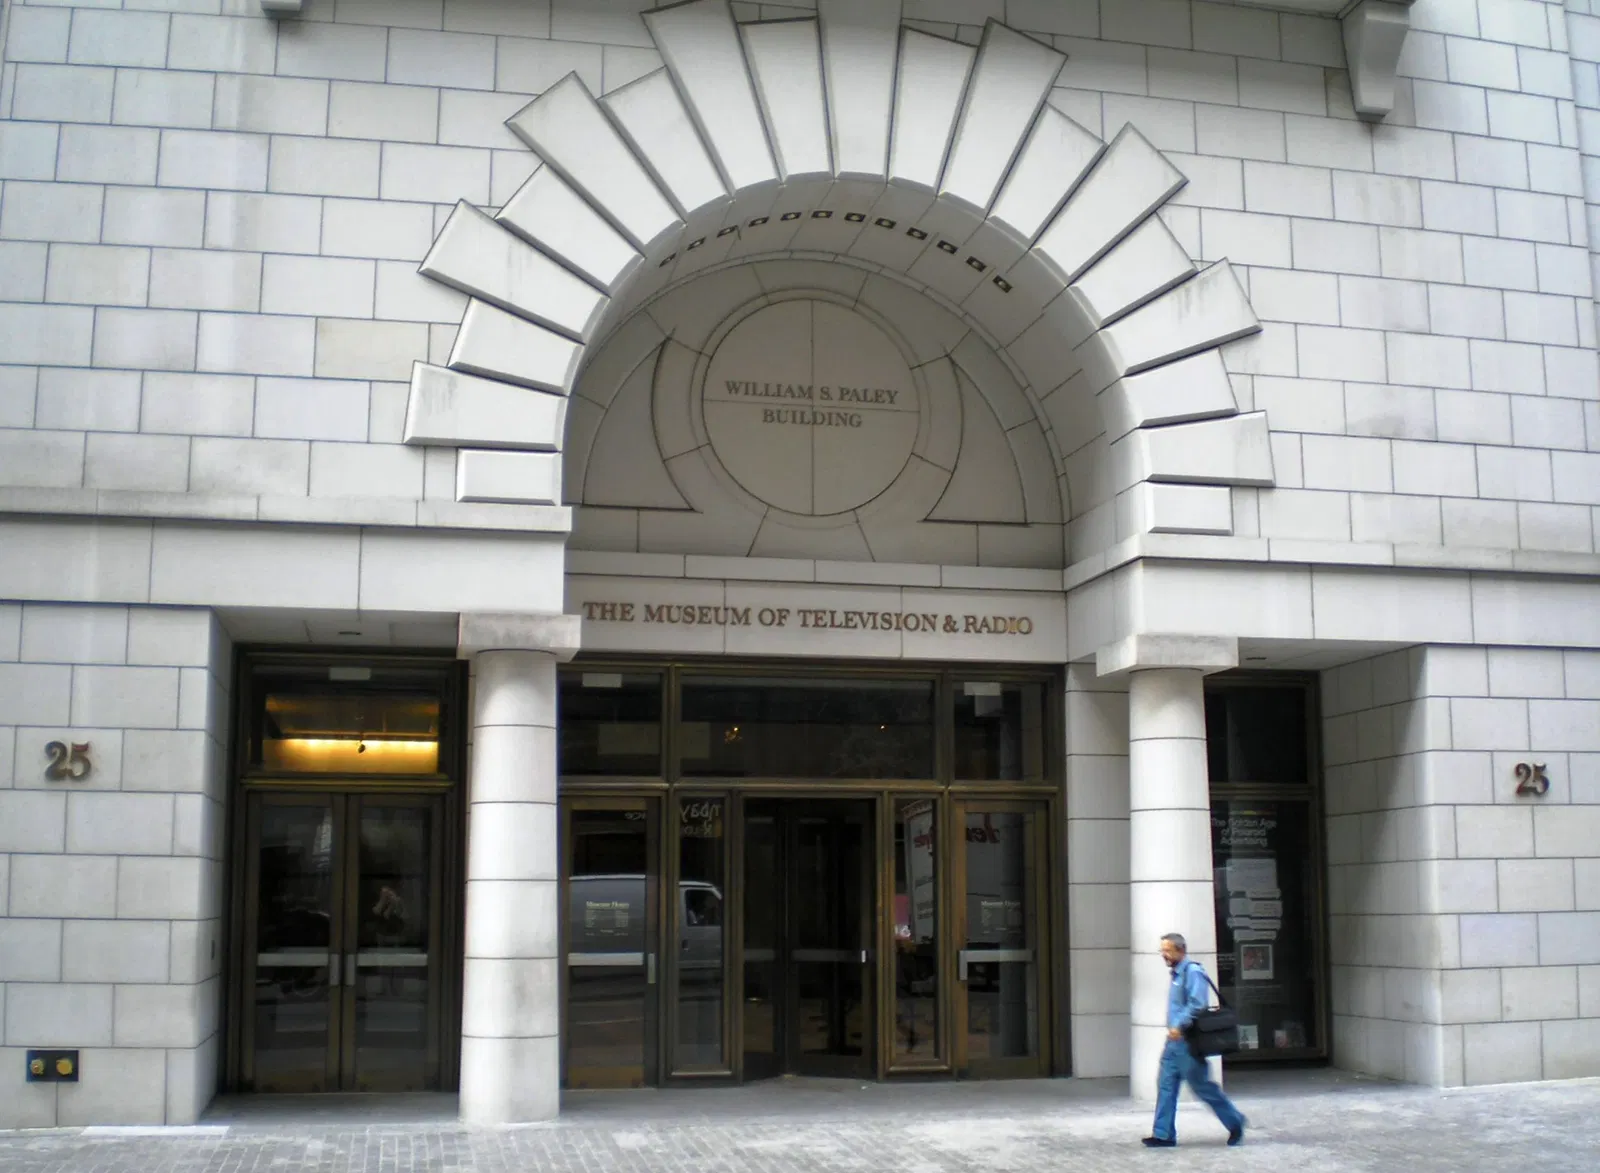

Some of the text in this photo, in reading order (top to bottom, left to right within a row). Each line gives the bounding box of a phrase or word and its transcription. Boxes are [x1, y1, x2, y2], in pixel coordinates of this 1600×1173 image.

[724, 380, 814, 399] WILLIAM
[838, 386, 899, 405] PALEY
[762, 408, 863, 428] BUILDING
[582, 602, 1034, 635] THE MUSEUM OF TELEVISION & RADIO
[44, 740, 92, 782] 25
[1514, 762, 1550, 798] 25
